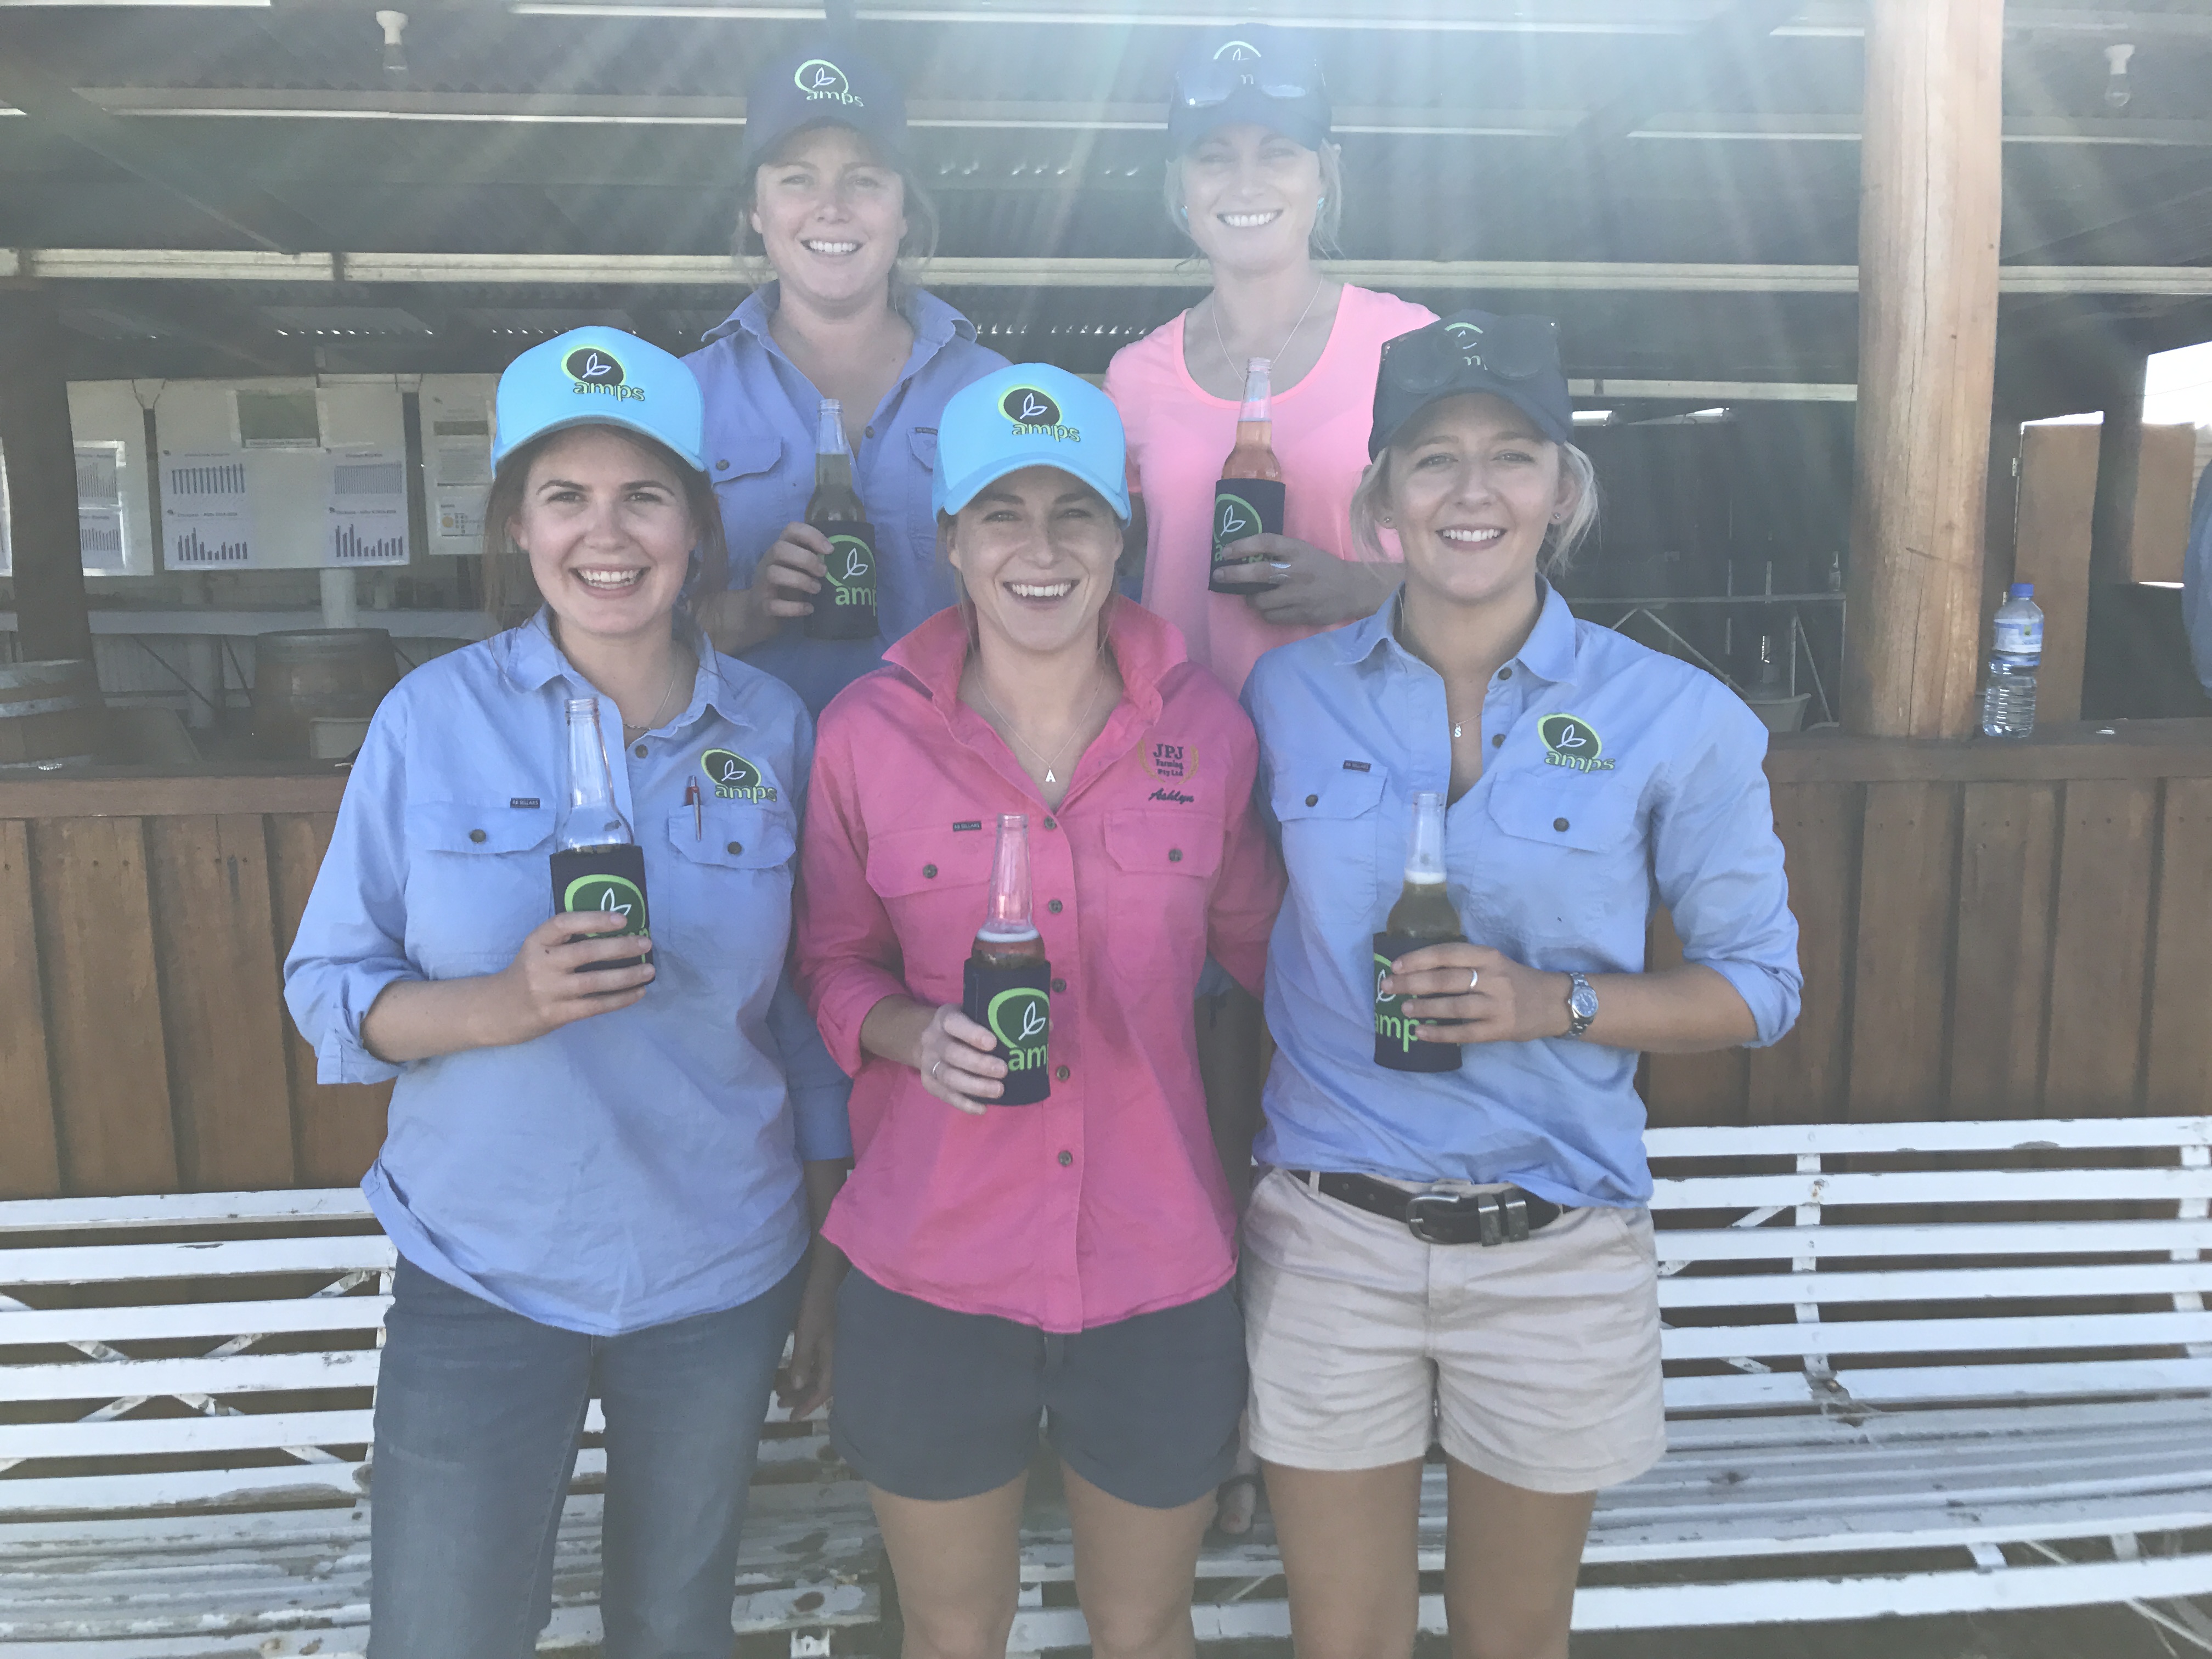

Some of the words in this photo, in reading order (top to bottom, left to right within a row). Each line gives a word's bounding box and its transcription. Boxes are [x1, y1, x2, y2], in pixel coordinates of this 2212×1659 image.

[806, 89, 864, 108] amps
[573, 381, 646, 403] amps
[1012, 423, 1081, 444] amps
[1454, 727, 1462, 737] S
[1153, 743, 1184, 760] JPJ
[1545, 751, 1615, 773] amps
[1045, 769, 1057, 783] A
[714, 785, 777, 804] amps
[1375, 1012, 1437, 1053] mp
[1008, 1042, 1048, 1075] am
